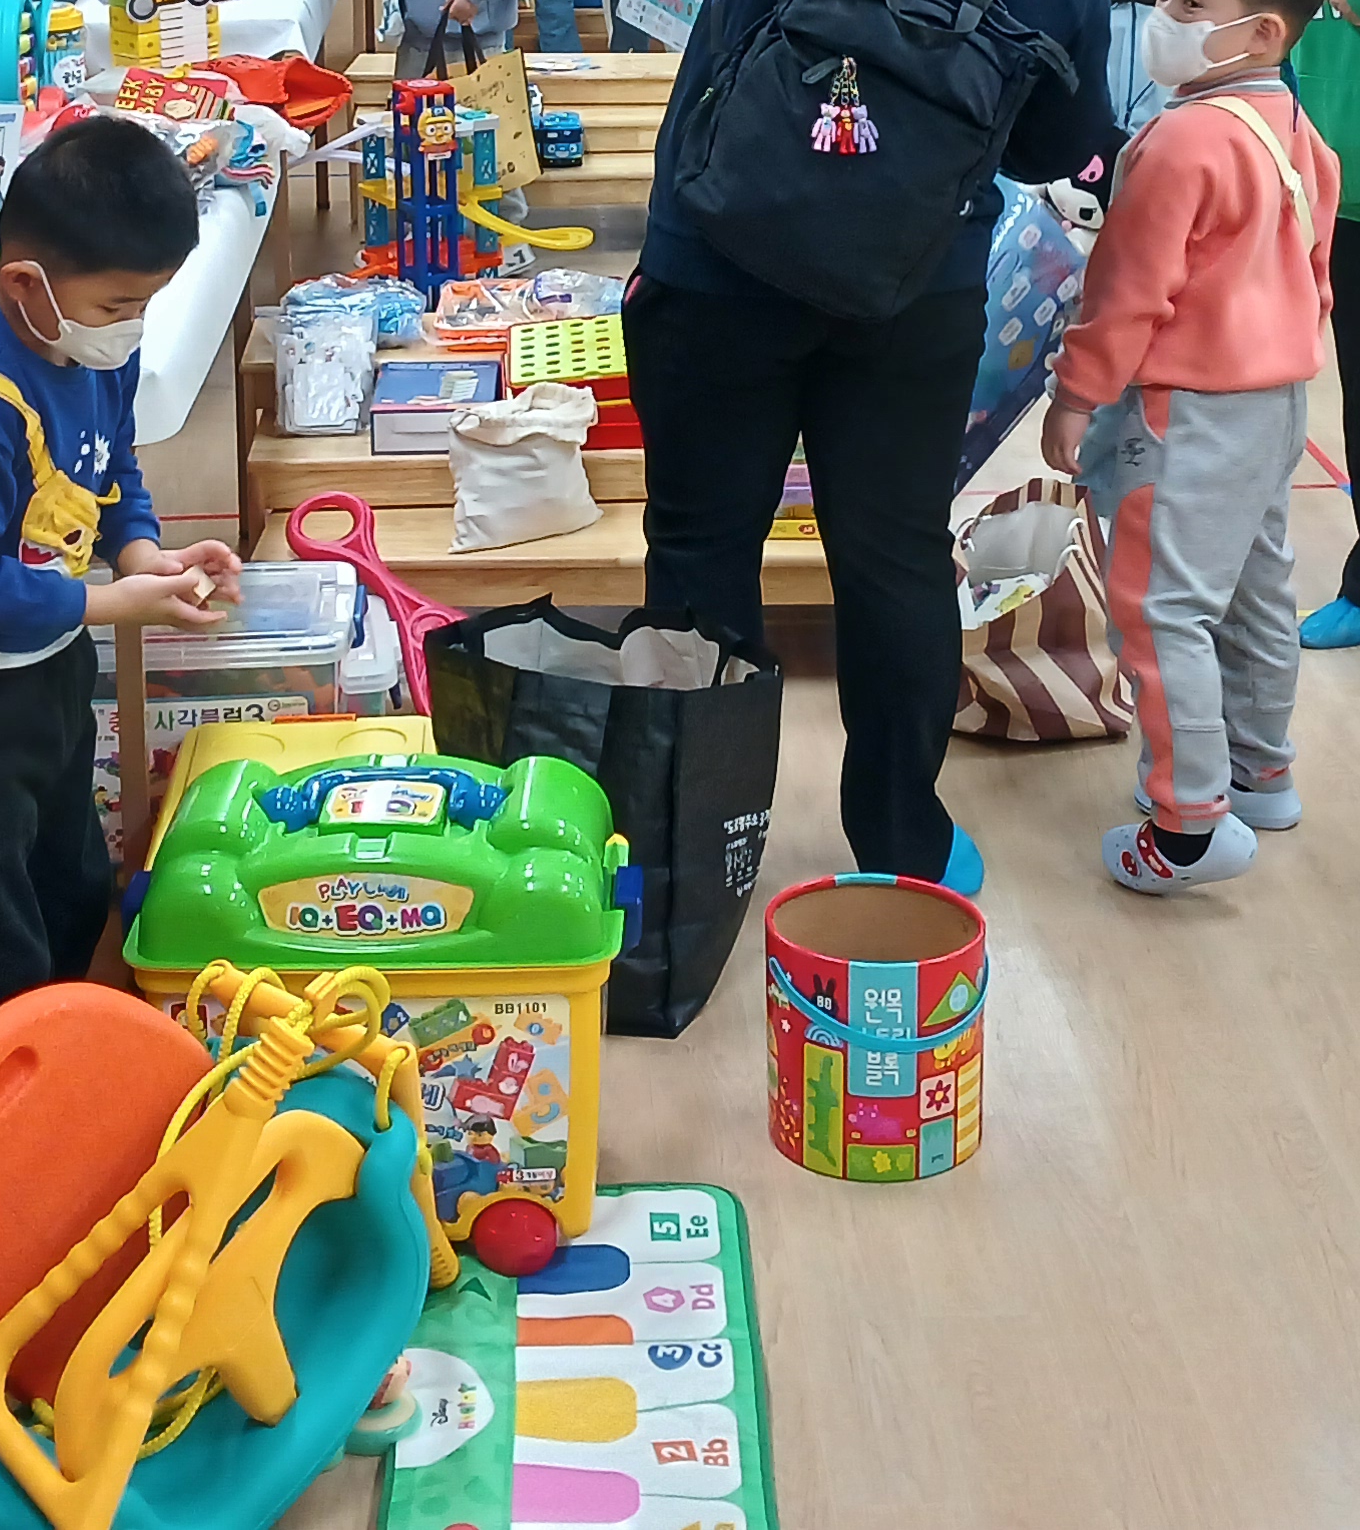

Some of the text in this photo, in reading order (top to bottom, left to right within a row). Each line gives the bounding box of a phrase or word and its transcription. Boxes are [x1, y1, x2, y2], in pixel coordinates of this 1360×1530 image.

[317, 878, 361, 901] PLAY
[494, 1002, 548, 1015] BB1101
[864, 988, 903, 1025] 원목
[653, 1221, 679, 1236] 5
[686, 1214, 710, 1239] Ee
[692, 1283, 716, 1311] Dd
[655, 1345, 683, 1362] 3
[662, 1444, 690, 1461] 2
[702, 1438, 730, 1468] Bb
